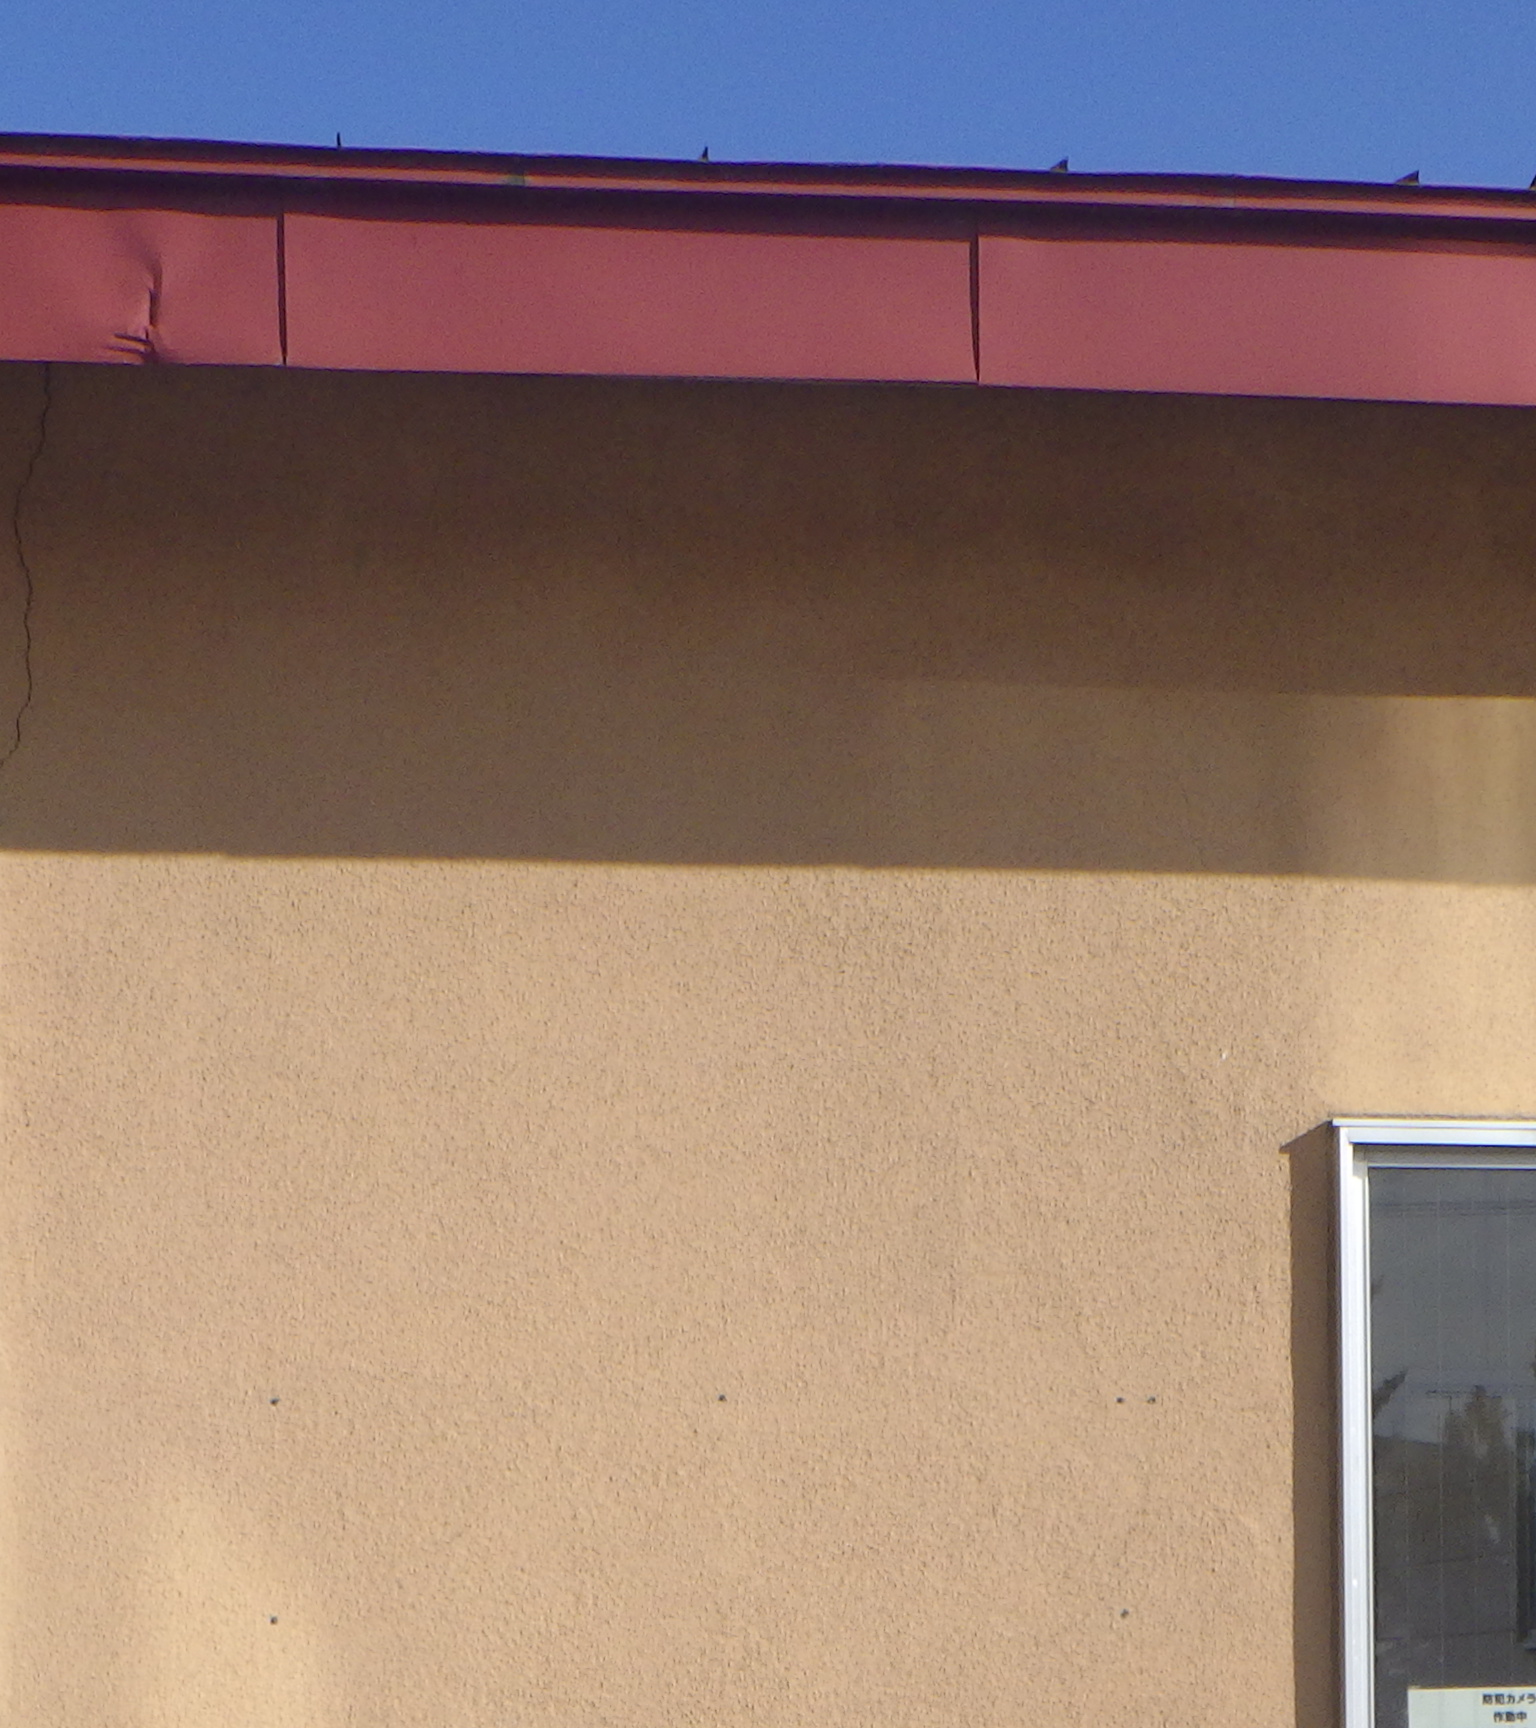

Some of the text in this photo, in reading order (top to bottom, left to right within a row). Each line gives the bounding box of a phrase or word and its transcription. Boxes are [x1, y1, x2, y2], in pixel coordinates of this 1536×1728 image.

[1482, 1693, 1536, 1705] 防犯カメラ
[1493, 1711, 1527, 1723] 作動中
